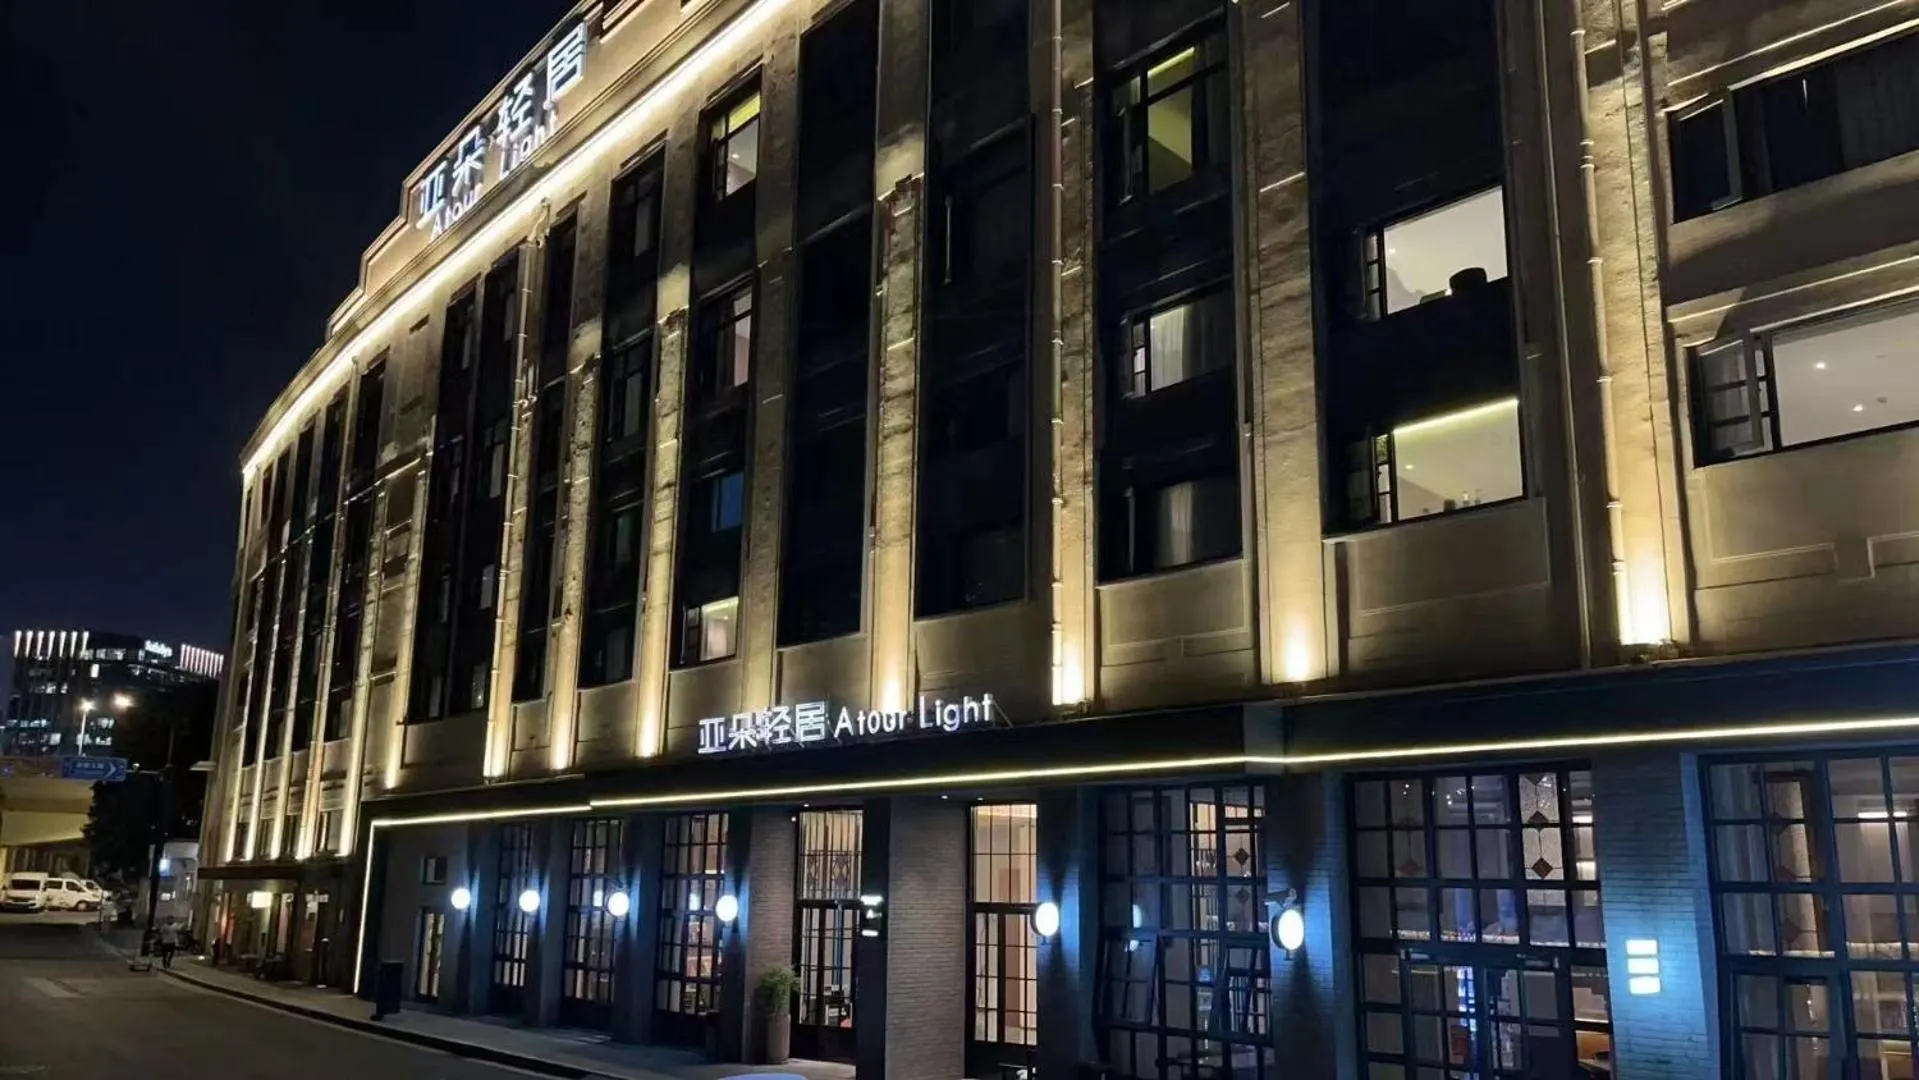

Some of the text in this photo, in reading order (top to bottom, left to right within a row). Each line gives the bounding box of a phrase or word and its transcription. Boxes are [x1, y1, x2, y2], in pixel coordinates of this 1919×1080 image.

[416, 22, 586, 229] 亚朵轻居
[428, 182, 483, 242] Atour
[698, 701, 828, 754] 亚朵轻居
[833, 693, 994, 739] Atour Light
